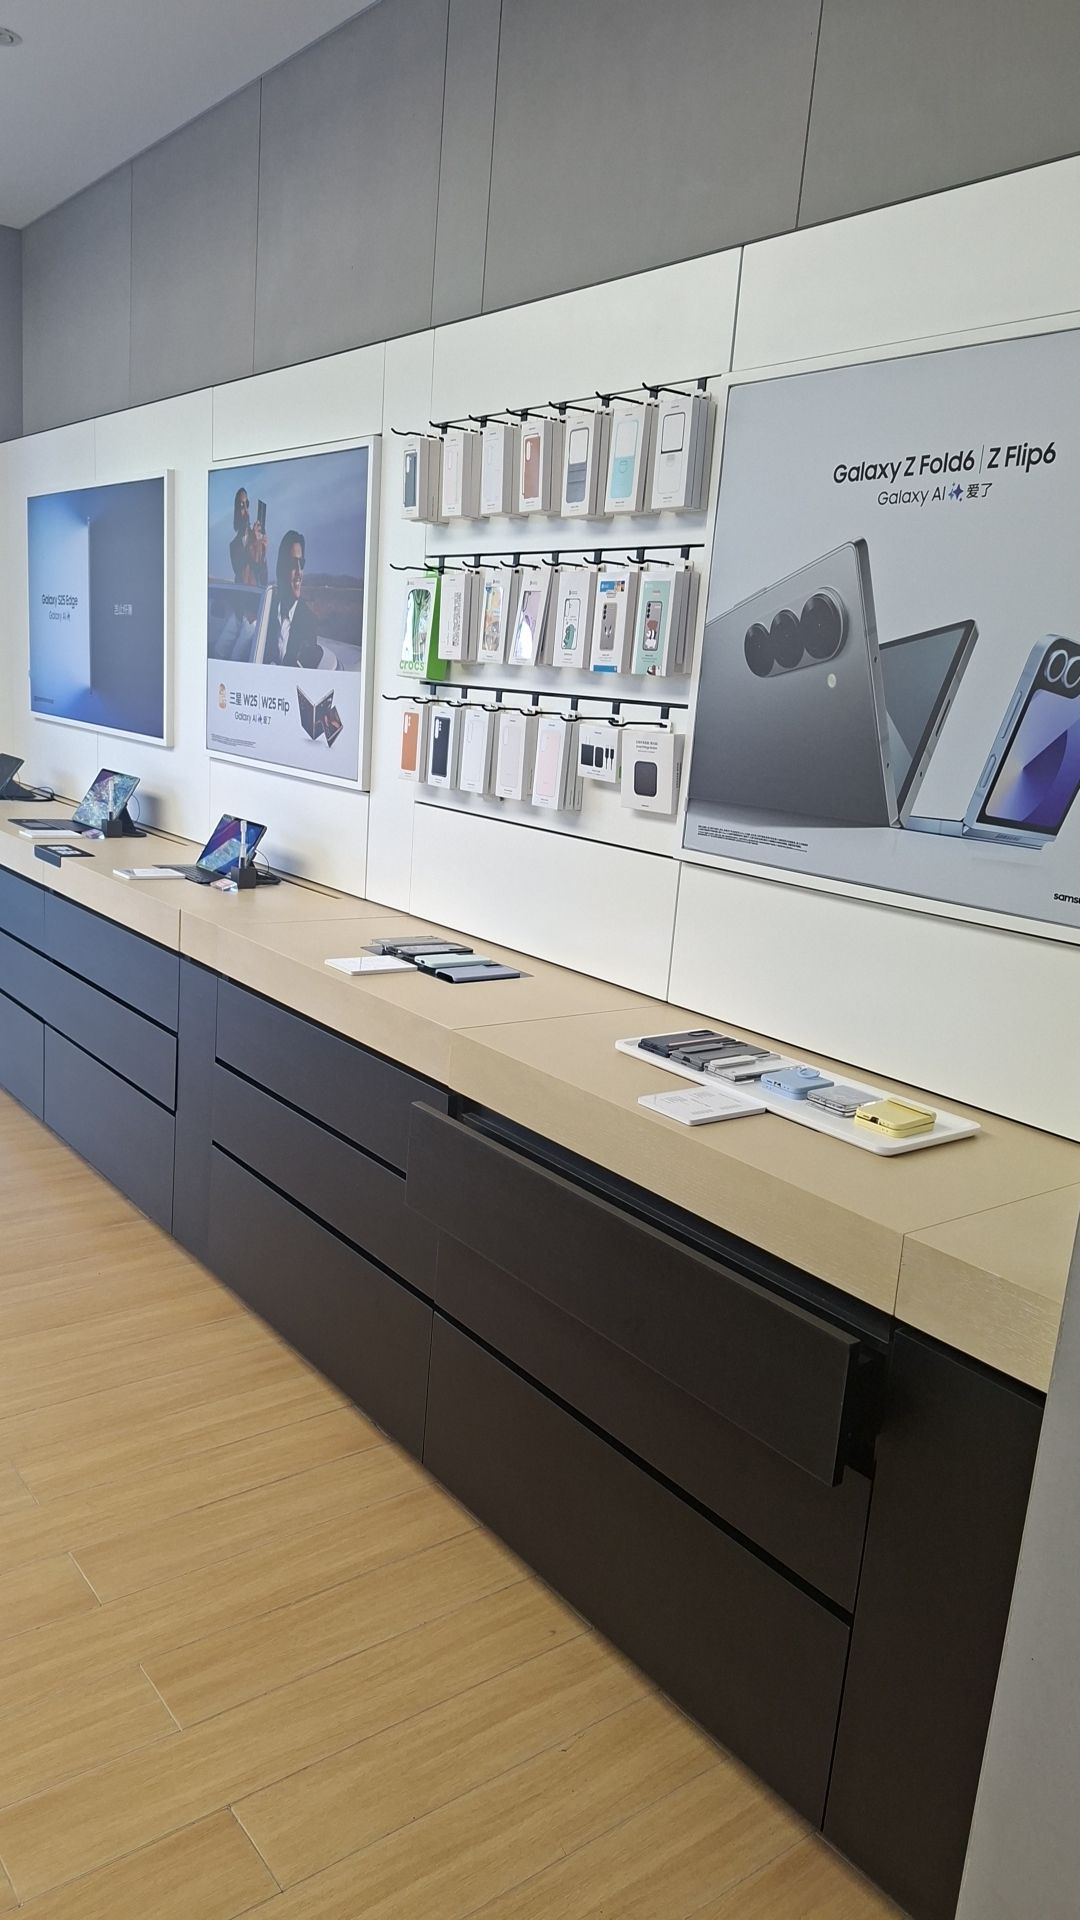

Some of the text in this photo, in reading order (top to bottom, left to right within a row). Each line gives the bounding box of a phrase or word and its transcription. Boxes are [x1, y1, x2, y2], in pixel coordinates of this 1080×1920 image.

[833, 442, 1057, 483] Galaxy Z Fold6 Z Flip6
[877, 482, 993, 507] Galaxy AI 爱了
[399, 659, 425, 671] crocs
[229, 691, 242, 706] 三星
[244, 694, 258, 707] W25
[262, 696, 277, 710] W25
[278, 698, 290, 716] Flip
[235, 712, 251, 724] Galaxy
[1053, 892, 1080, 905] sams
